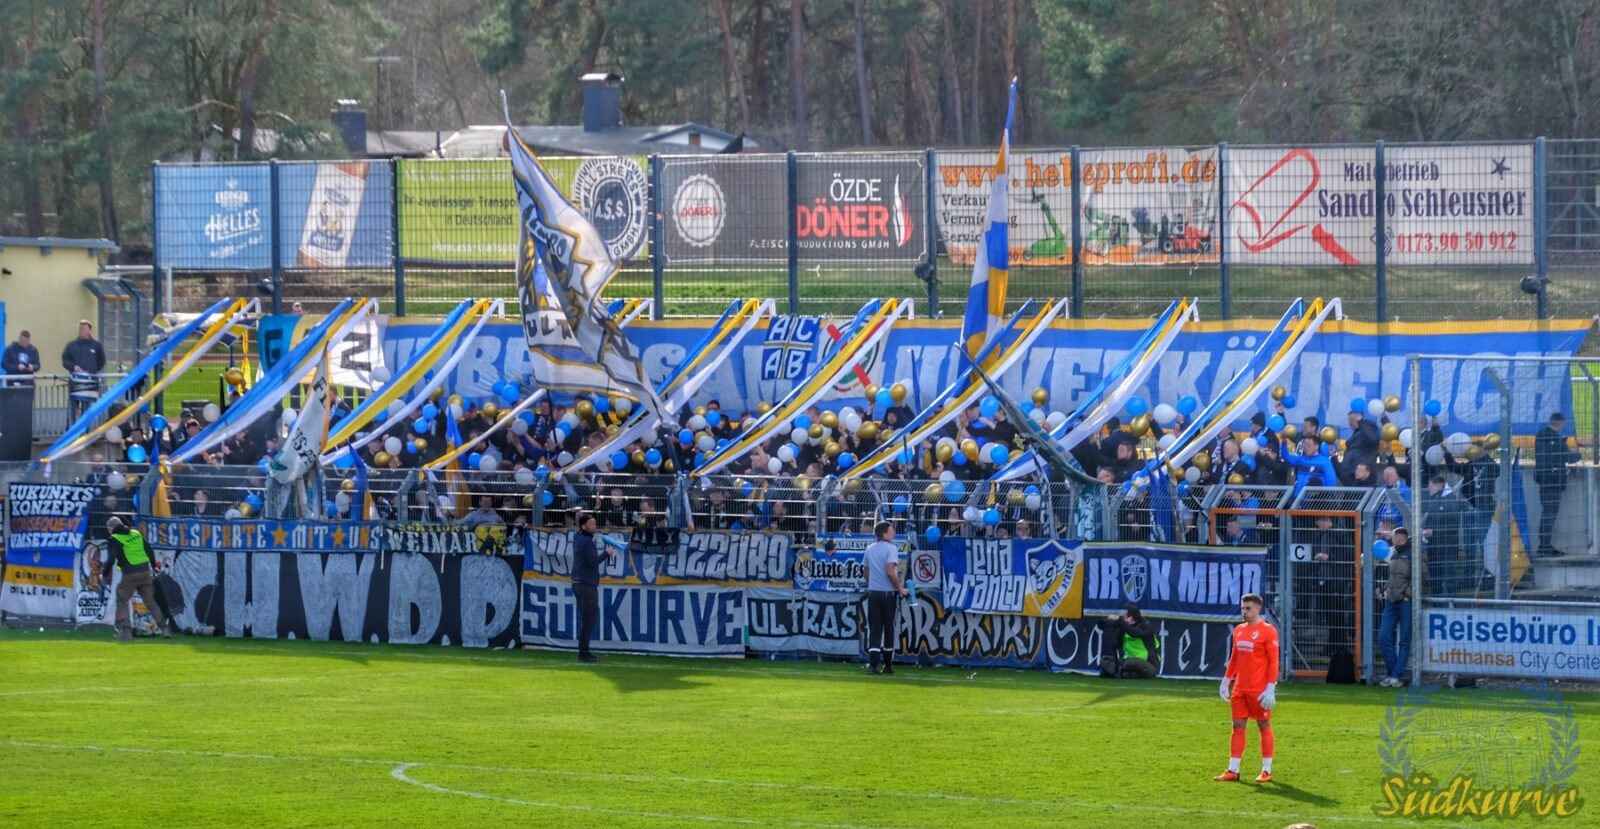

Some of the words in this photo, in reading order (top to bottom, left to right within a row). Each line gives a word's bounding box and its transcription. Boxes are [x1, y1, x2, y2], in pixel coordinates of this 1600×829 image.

[1344, 161, 1439, 182] Malbetrieb
[829, 172, 882, 202] ÖZDE
[469, 196, 517, 210] Transpo
[942, 194, 990, 207] Verkau
[1318, 188, 1396, 218] Sando
[1402, 187, 1526, 218] Schleusner
[796, 197, 889, 238] DÖNER
[942, 212, 1018, 229] Vermieg
[943, 230, 981, 242] Servic
[1465, 230, 1484, 252] 50
[1489, 230, 1517, 252] 912
[526, 313, 574, 341] ULT
[10, 485, 94, 501] ZUKUNFTS
[12, 500, 87, 516] KONZEPT
[10, 532, 83, 549] UMSETZEN
[291, 524, 328, 549] MIT
[349, 525, 380, 549] UNS
[386, 528, 480, 553] WEIMAR
[1294, 545, 1306, 561] C
[846, 558, 867, 580] Fes
[522, 582, 744, 646] SÜKURVE
[750, 600, 858, 638] ULTRAS
[862, 595, 1039, 656] ARAKIRI
[1429, 613, 1577, 646] Reisebüro
[1587, 619, 1600, 646] I
[1429, 647, 1515, 667] Lufthansa
[1520, 650, 1549, 673] City
[1554, 652, 1600, 670] Cente
